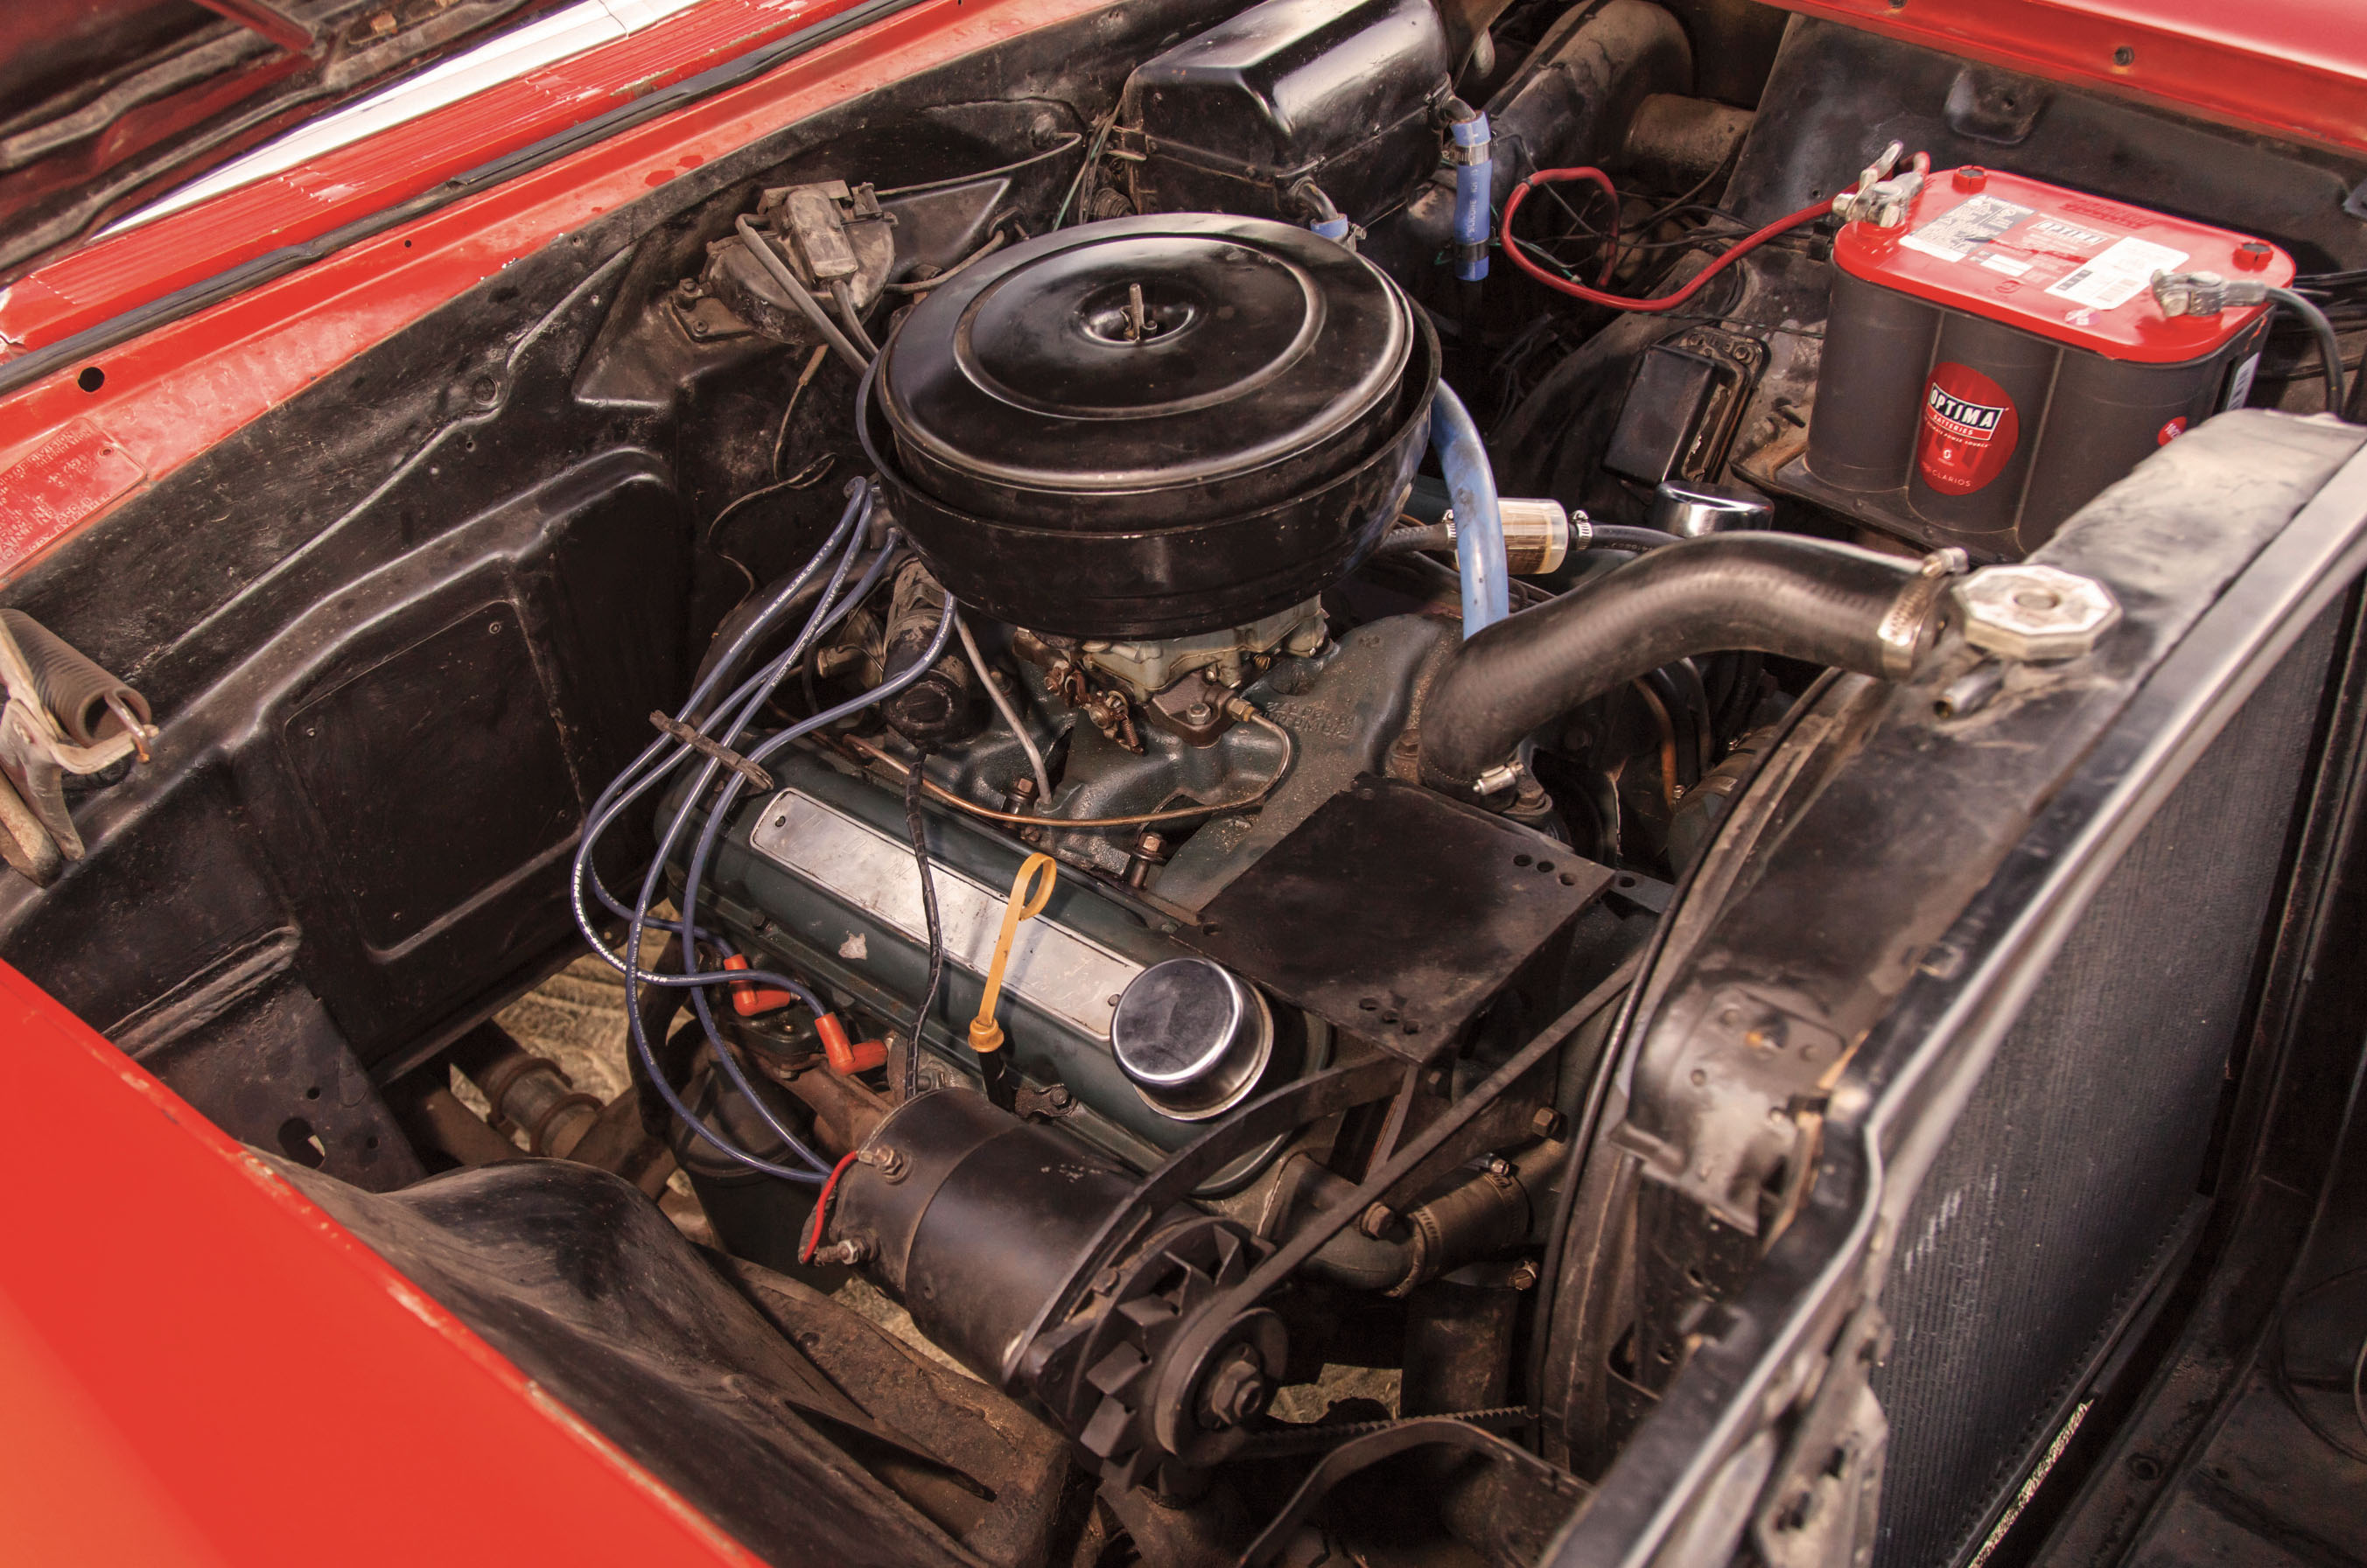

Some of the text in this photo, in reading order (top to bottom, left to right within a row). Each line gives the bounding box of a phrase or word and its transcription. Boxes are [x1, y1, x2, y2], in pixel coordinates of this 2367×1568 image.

[1930, 389, 1994, 427] OPTIMA
[1933, 415, 1973, 436] BATTERIES
[1932, 469, 1971, 487] CLARIOS
[573, 863, 583, 897] POWER
